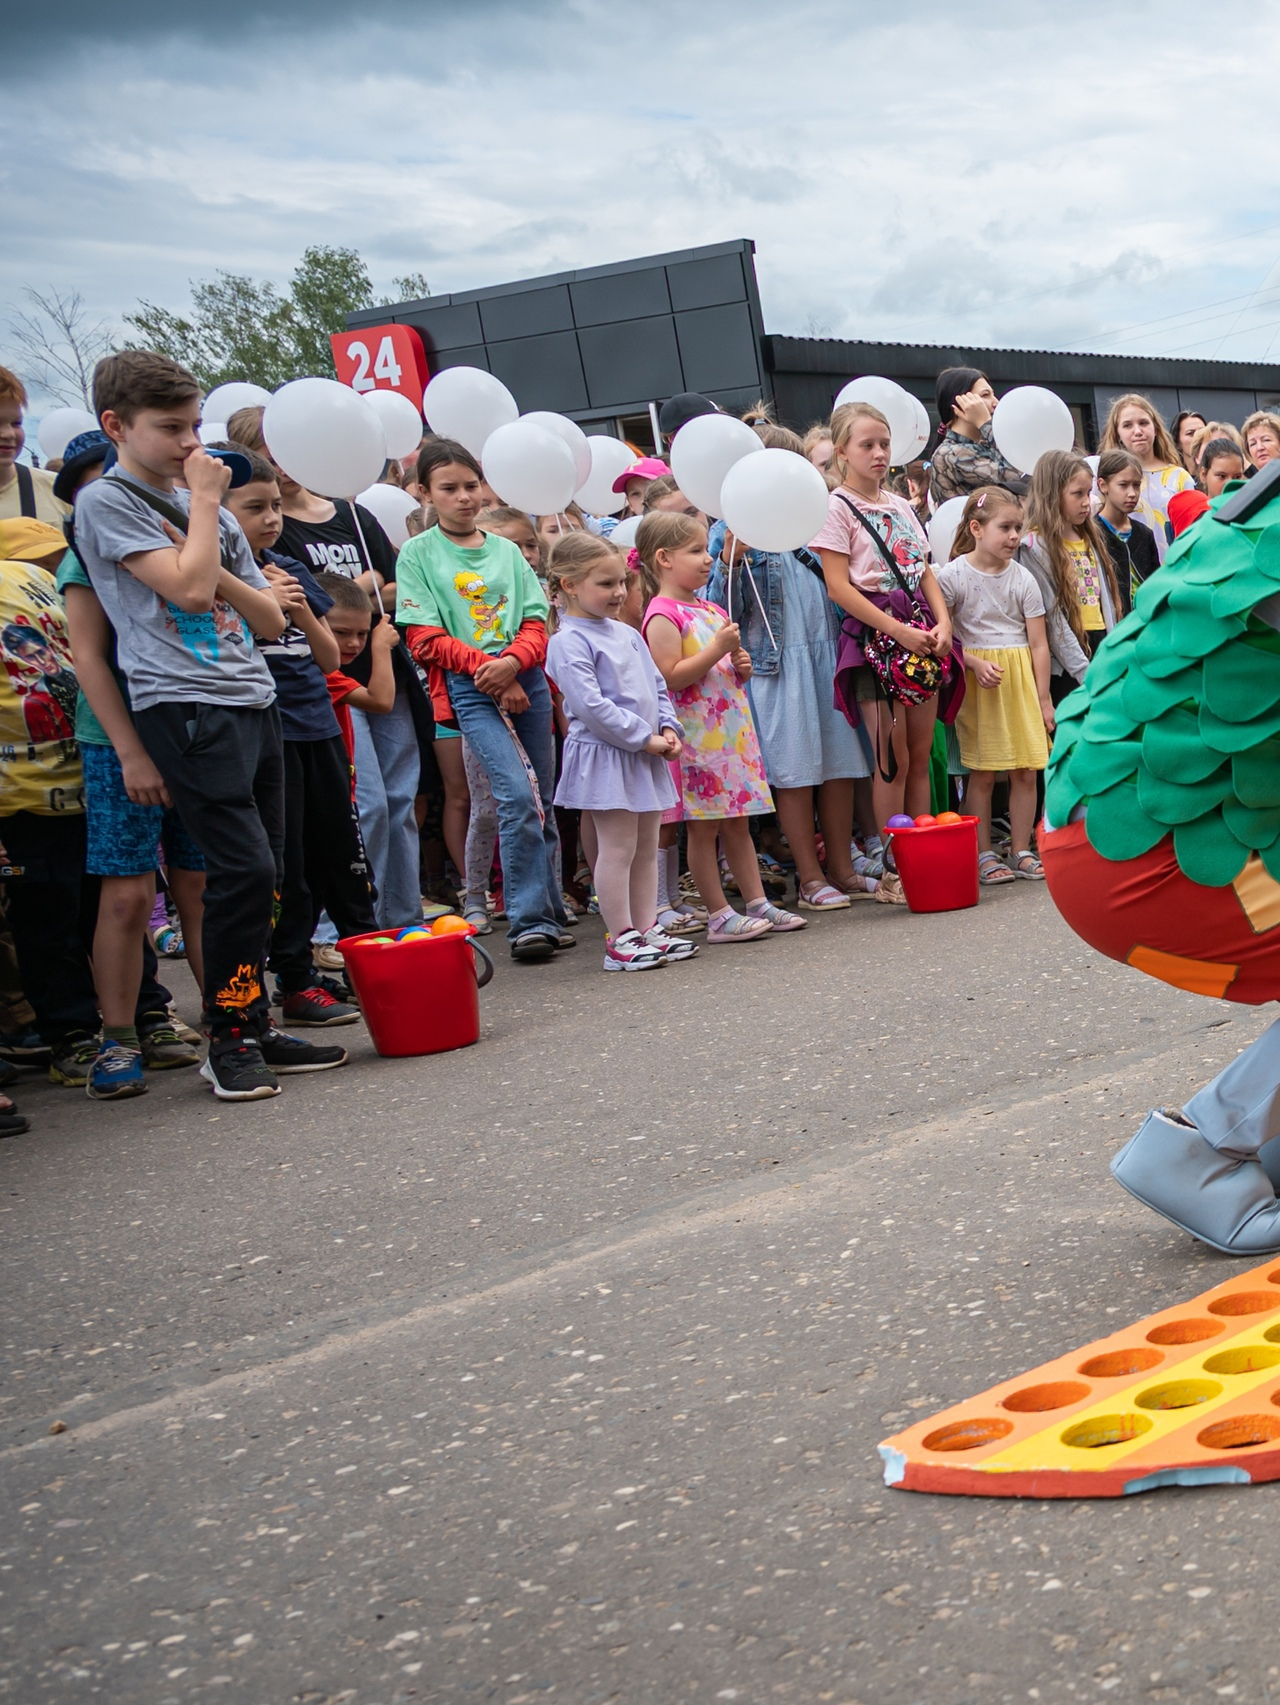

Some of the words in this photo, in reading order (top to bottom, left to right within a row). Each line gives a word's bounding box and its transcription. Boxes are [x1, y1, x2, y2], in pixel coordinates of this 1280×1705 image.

[346, 335, 403, 393] 24
[305, 543, 360, 566] Mon
[165, 615, 218, 624] SCHOOL
[176, 626, 218, 635] GLASS
